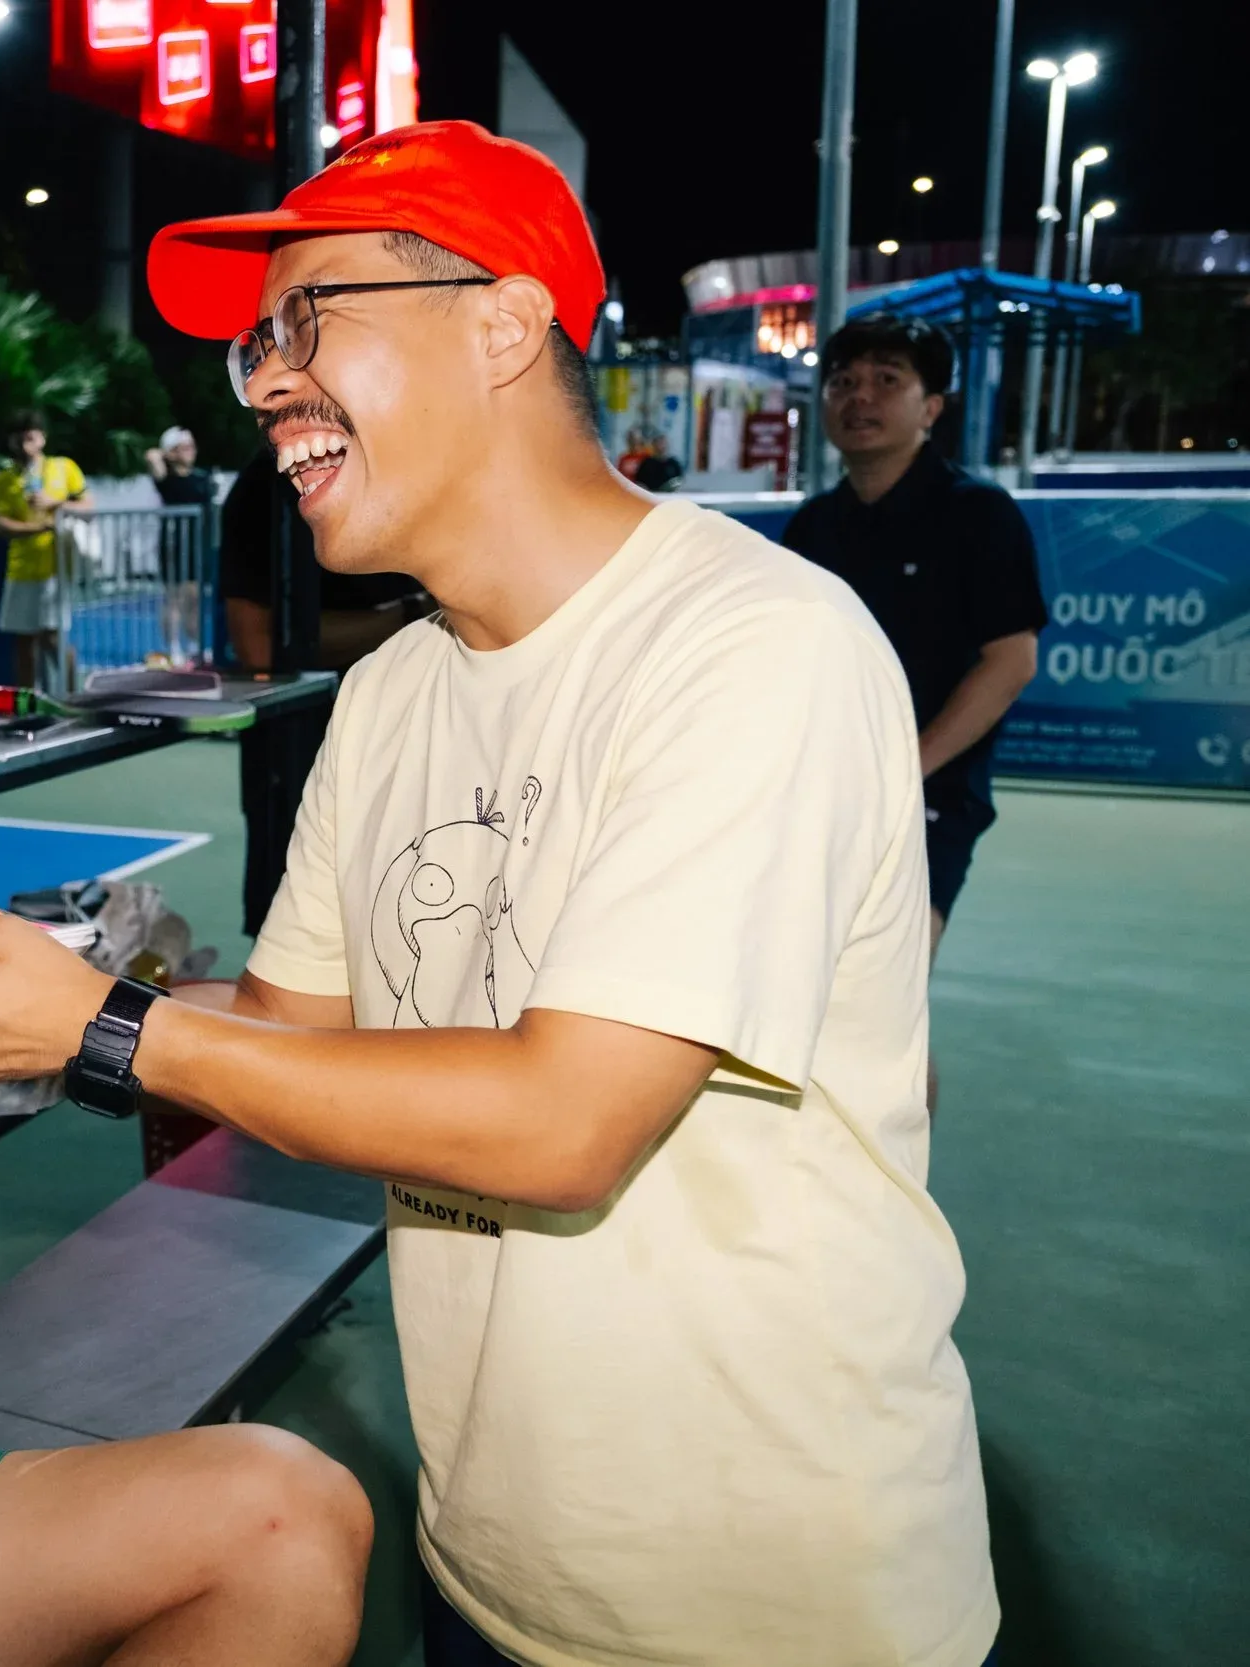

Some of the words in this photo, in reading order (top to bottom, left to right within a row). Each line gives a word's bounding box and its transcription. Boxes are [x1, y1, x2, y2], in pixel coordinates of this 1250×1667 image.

[1053, 593, 1134, 627] QUY
[1145, 588, 1205, 626] MÔ
[1047, 633, 1184, 685] QUỐC
[391, 1183, 459, 1225] ALREADY
